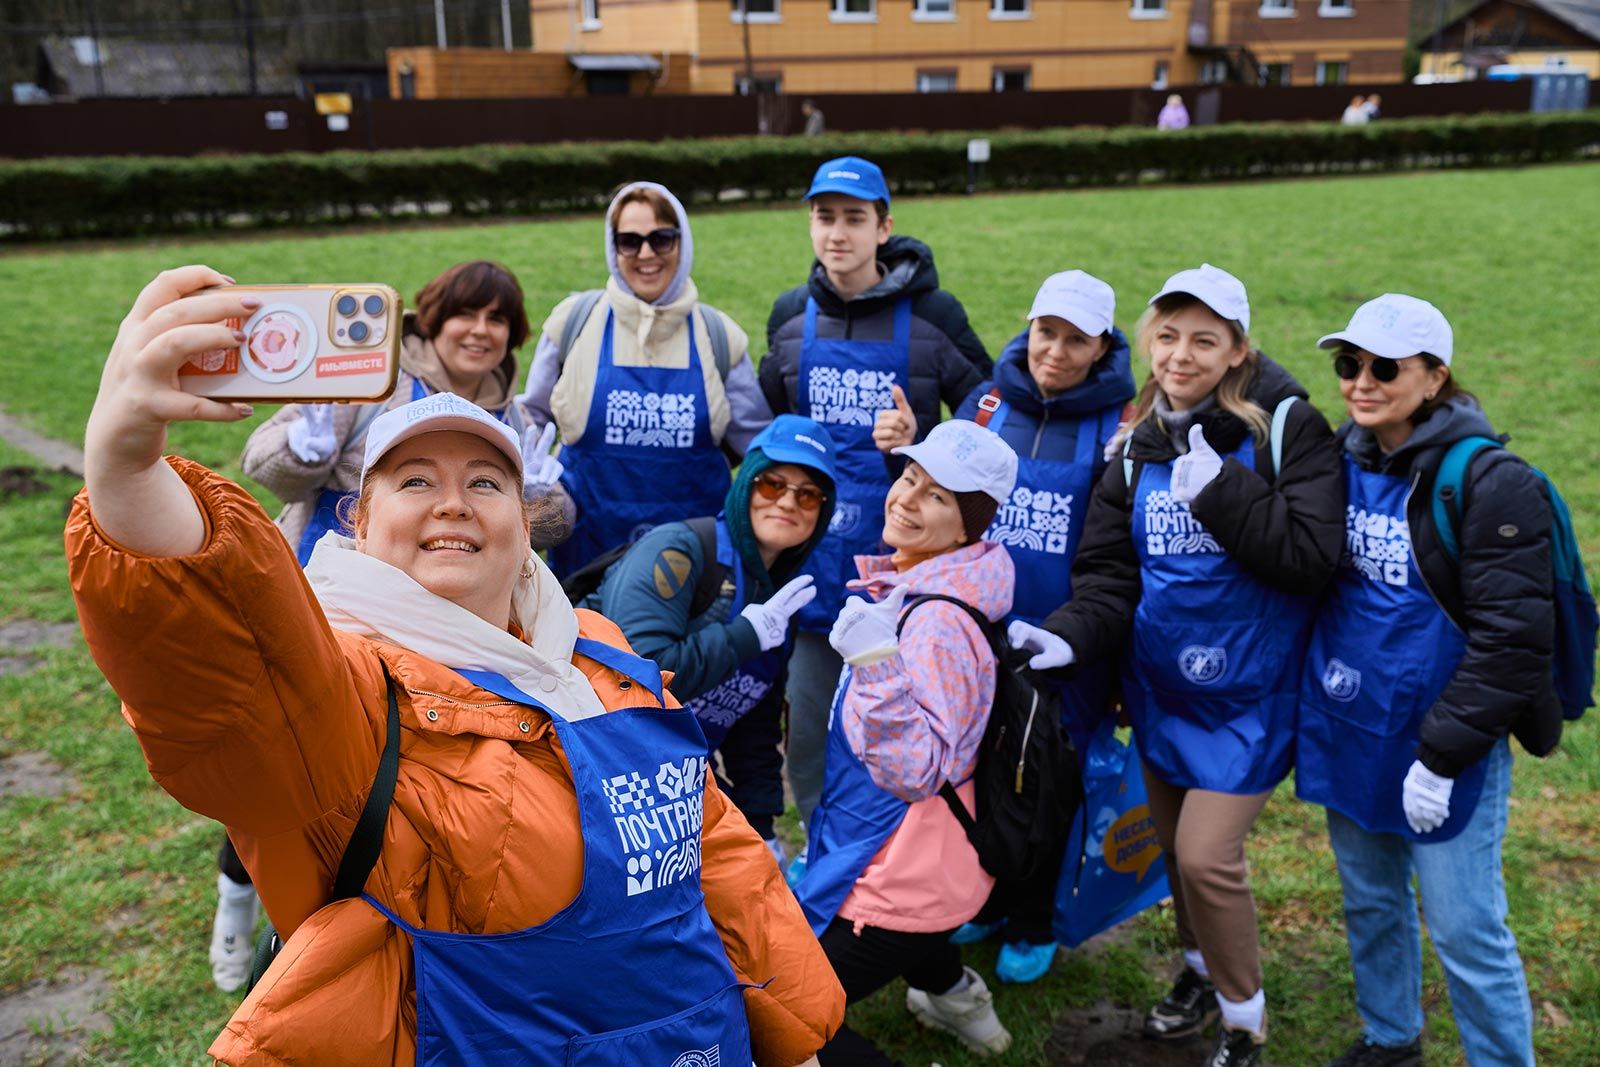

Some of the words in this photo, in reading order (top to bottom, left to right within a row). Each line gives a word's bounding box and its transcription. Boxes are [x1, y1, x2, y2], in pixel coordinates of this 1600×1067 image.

[319, 358, 383, 373] #МЫВМЕСТЕ
[808, 384, 858, 406] ПОЧТА
[406, 401, 455, 419] ПОЧТА
[606, 408, 660, 429] ПОЧТА
[997, 504, 1029, 529] ЧТА
[703, 684, 743, 710] ОЧТА
[614, 800, 691, 854] ПОЧТА
